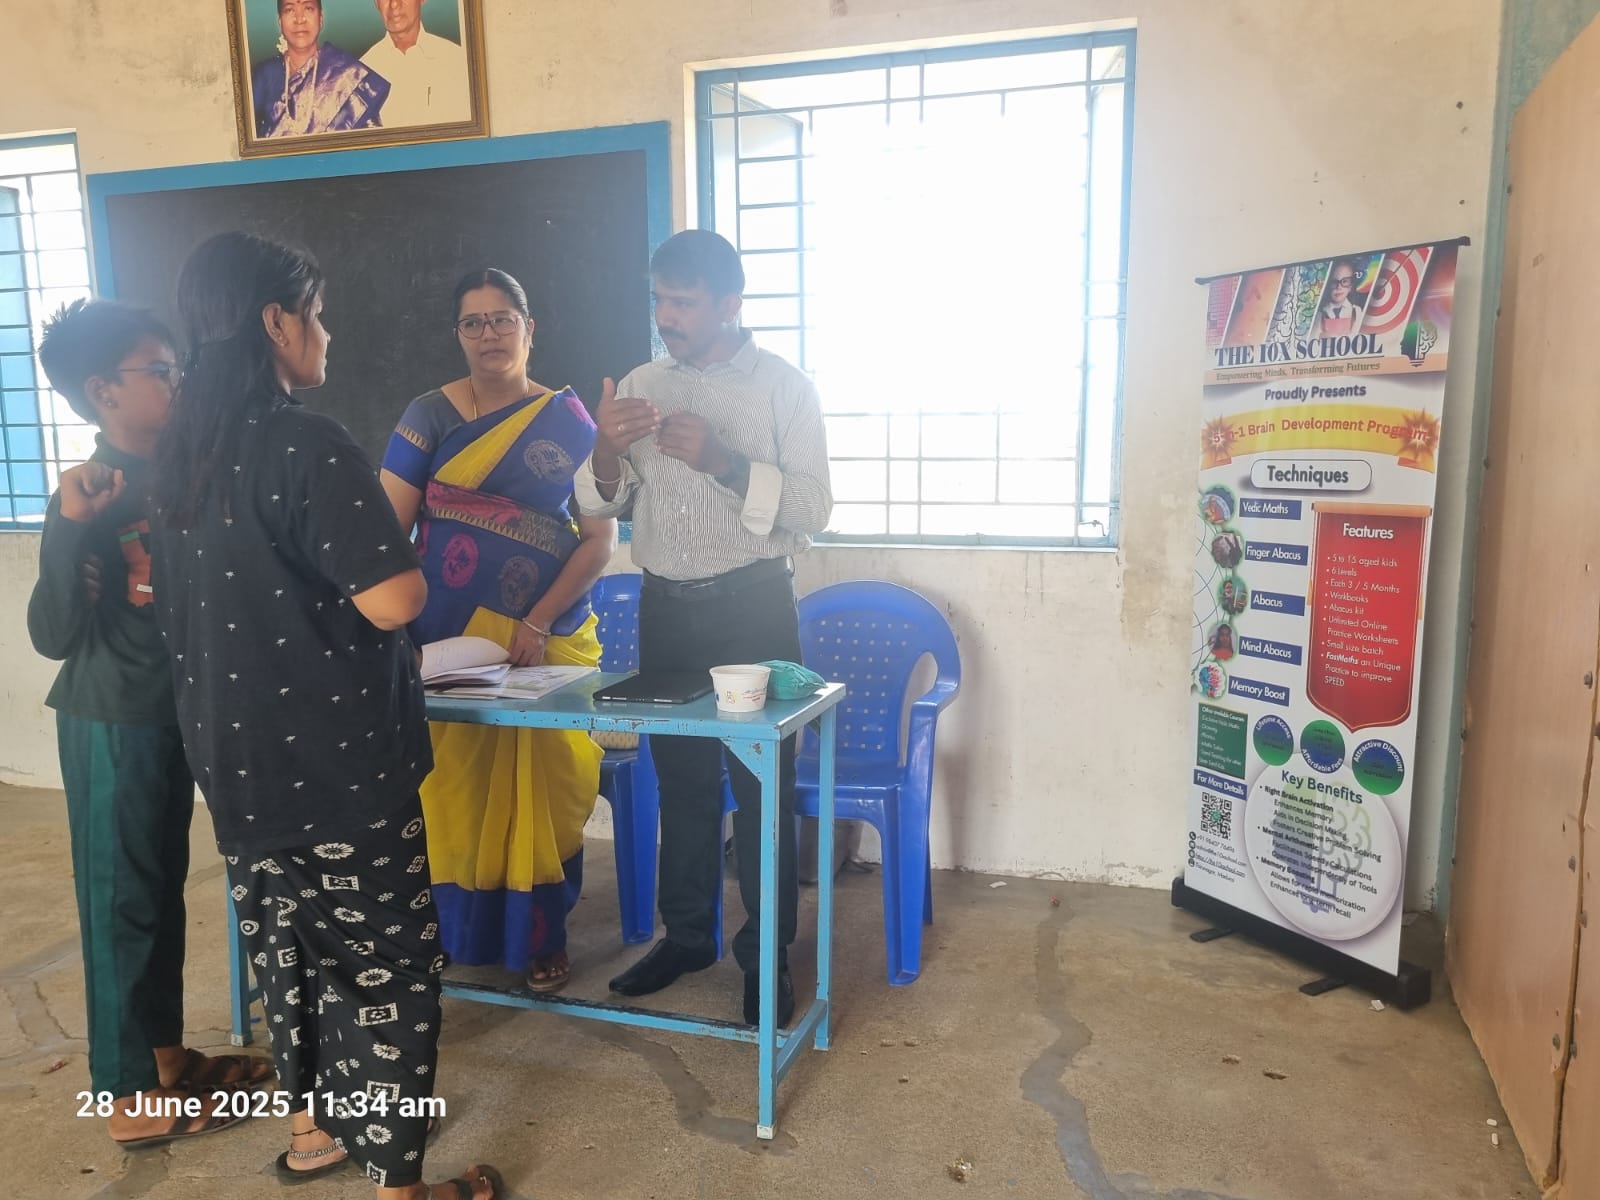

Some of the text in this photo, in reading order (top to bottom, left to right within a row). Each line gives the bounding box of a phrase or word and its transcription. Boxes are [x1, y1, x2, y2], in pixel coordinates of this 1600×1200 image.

[1215, 344, 1254, 367] THE
[1295, 333, 1383, 360] SCHOOL
[1216, 371, 1263, 382] Empowering
[1290, 365, 1344, 376] Transforming
[1347, 362, 1381, 372] Futures
[1265, 385, 1366, 402] Proudly Presents
[1248, 421, 1276, 436] Brain
[1281, 418, 1364, 433] Development
[1267, 464, 1349, 487] Techniques
[1242, 501, 1289, 514] Vedic Maths
[1343, 522, 1394, 539] Features
[1246, 545, 1302, 560] Finger Abacus
[1358, 557, 1380, 567] aged
[1381, 557, 1398, 567] kids
[1337, 567, 1357, 577] Levels
[1330, 578, 1346, 588] Each
[1347, 580, 1353, 589] 3
[1363, 582, 1368, 591] 5
[1370, 583, 1400, 594] Months
[1252, 594, 1283, 607] Abacus
[1330, 591, 1369, 603] Workbooks
[1329, 603, 1364, 615] Abacus kit
[1328, 615, 1388, 631] Unlimited Online
[1327, 627, 1399, 645] Practice Worksheets
[1241, 639, 1292, 659] Mind Abacus
[1326, 639, 1344, 650] Small
[1361, 645, 1384, 656] batch
[1325, 663, 1393, 683] Practice to improve
[1373, 660, 1401, 671] Unique
[1324, 675, 1345, 687] SPEED
[1230, 679, 1286, 701] Memory Boost
[1382, 742, 1404, 773] Discount
[1197, 773, 1244, 796] For More Details
[1281, 769, 1363, 804] Key Benefits
[1264, 785, 1334, 813] Right Brain Activation
[1304, 808, 1333, 824] Memory
[1262, 826, 1284, 839] Mental
[1296, 826, 1325, 841] Creative
[1354, 846, 1382, 863] Solving
[1260, 856, 1286, 873] Memory
[1329, 859, 1372, 881] Calculations
[1270, 870, 1291, 883] Allows
[1348, 879, 1358, 888] of
[1358, 881, 1378, 895] Tools
